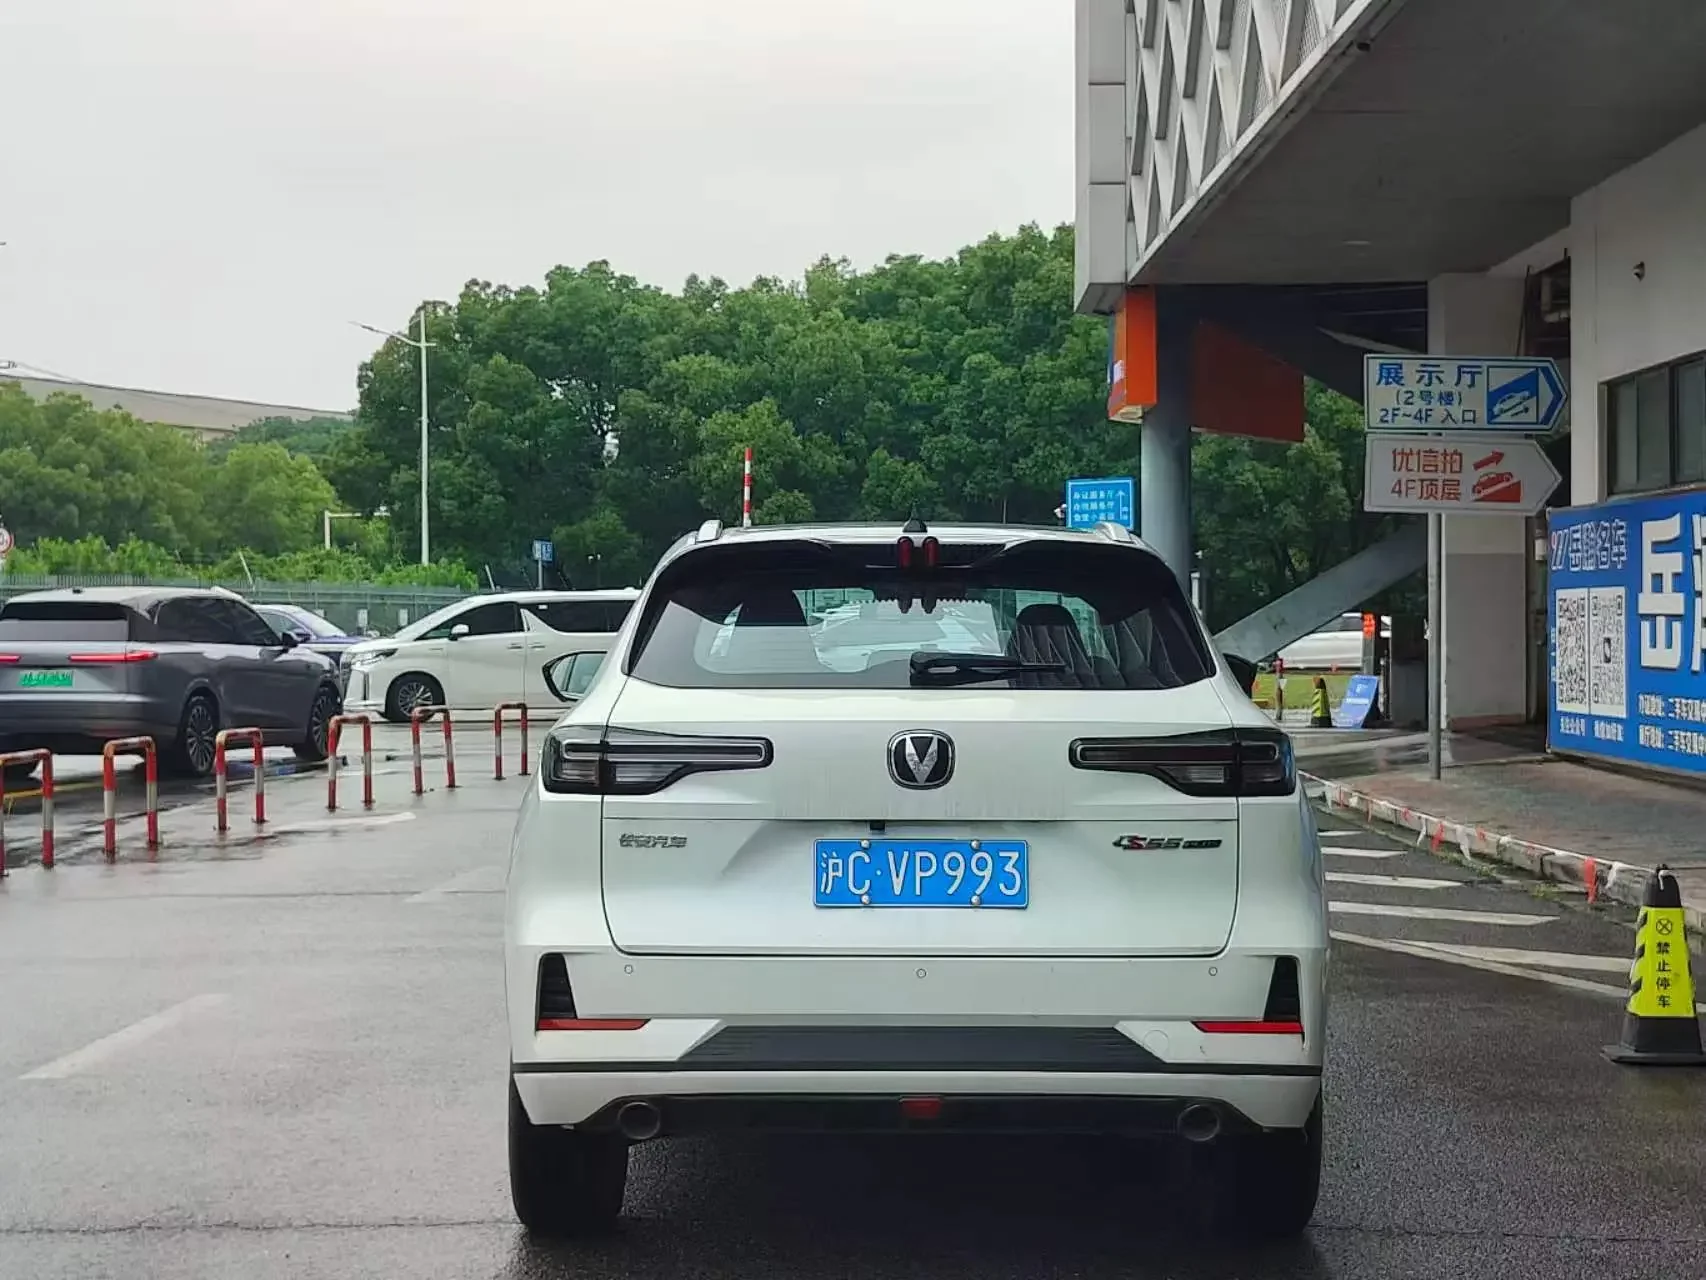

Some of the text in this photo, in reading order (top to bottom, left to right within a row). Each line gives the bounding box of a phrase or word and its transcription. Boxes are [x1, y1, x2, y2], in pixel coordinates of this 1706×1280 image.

[1376, 362, 1483, 389] 展示厅
[1380, 408, 1476, 424] 2F~4F 入口
[1392, 449, 1463, 474] 优信拍
[1391, 479, 1461, 501] 4F顶层
[820, 851, 1022, 896] 沪C·VP993
[1656, 942, 1671, 1008] 禁止停车
